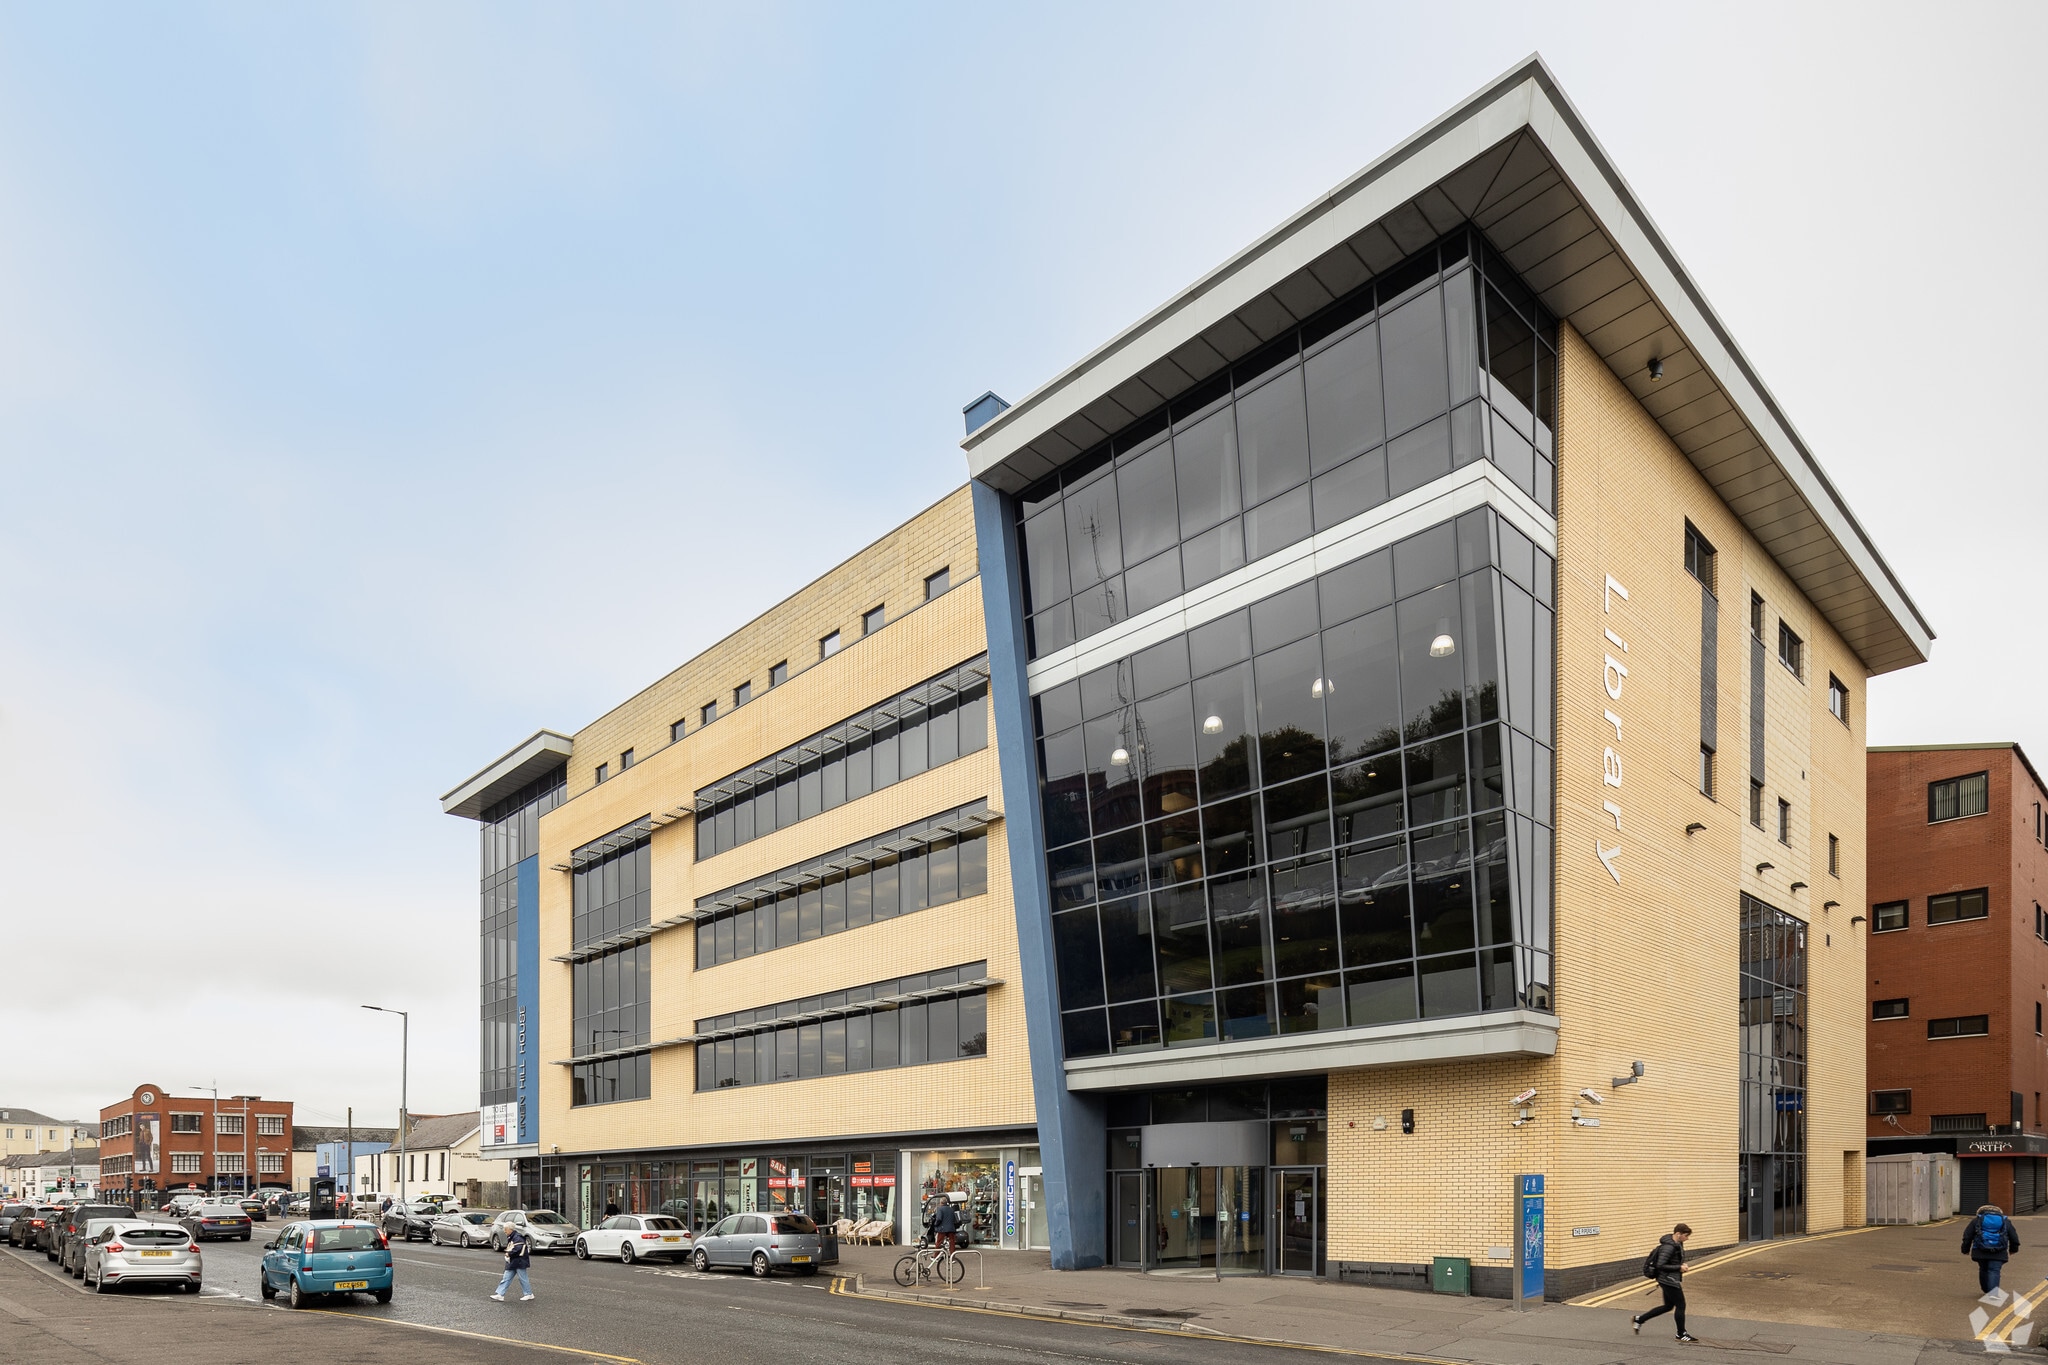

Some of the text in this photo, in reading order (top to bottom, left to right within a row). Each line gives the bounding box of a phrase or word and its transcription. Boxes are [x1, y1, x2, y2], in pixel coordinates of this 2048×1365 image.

[1596, 572, 1629, 885] Library
[518, 1005, 527, 1138] LINEN HILL HOUSE
[770, 1159, 786, 1175] SALE
